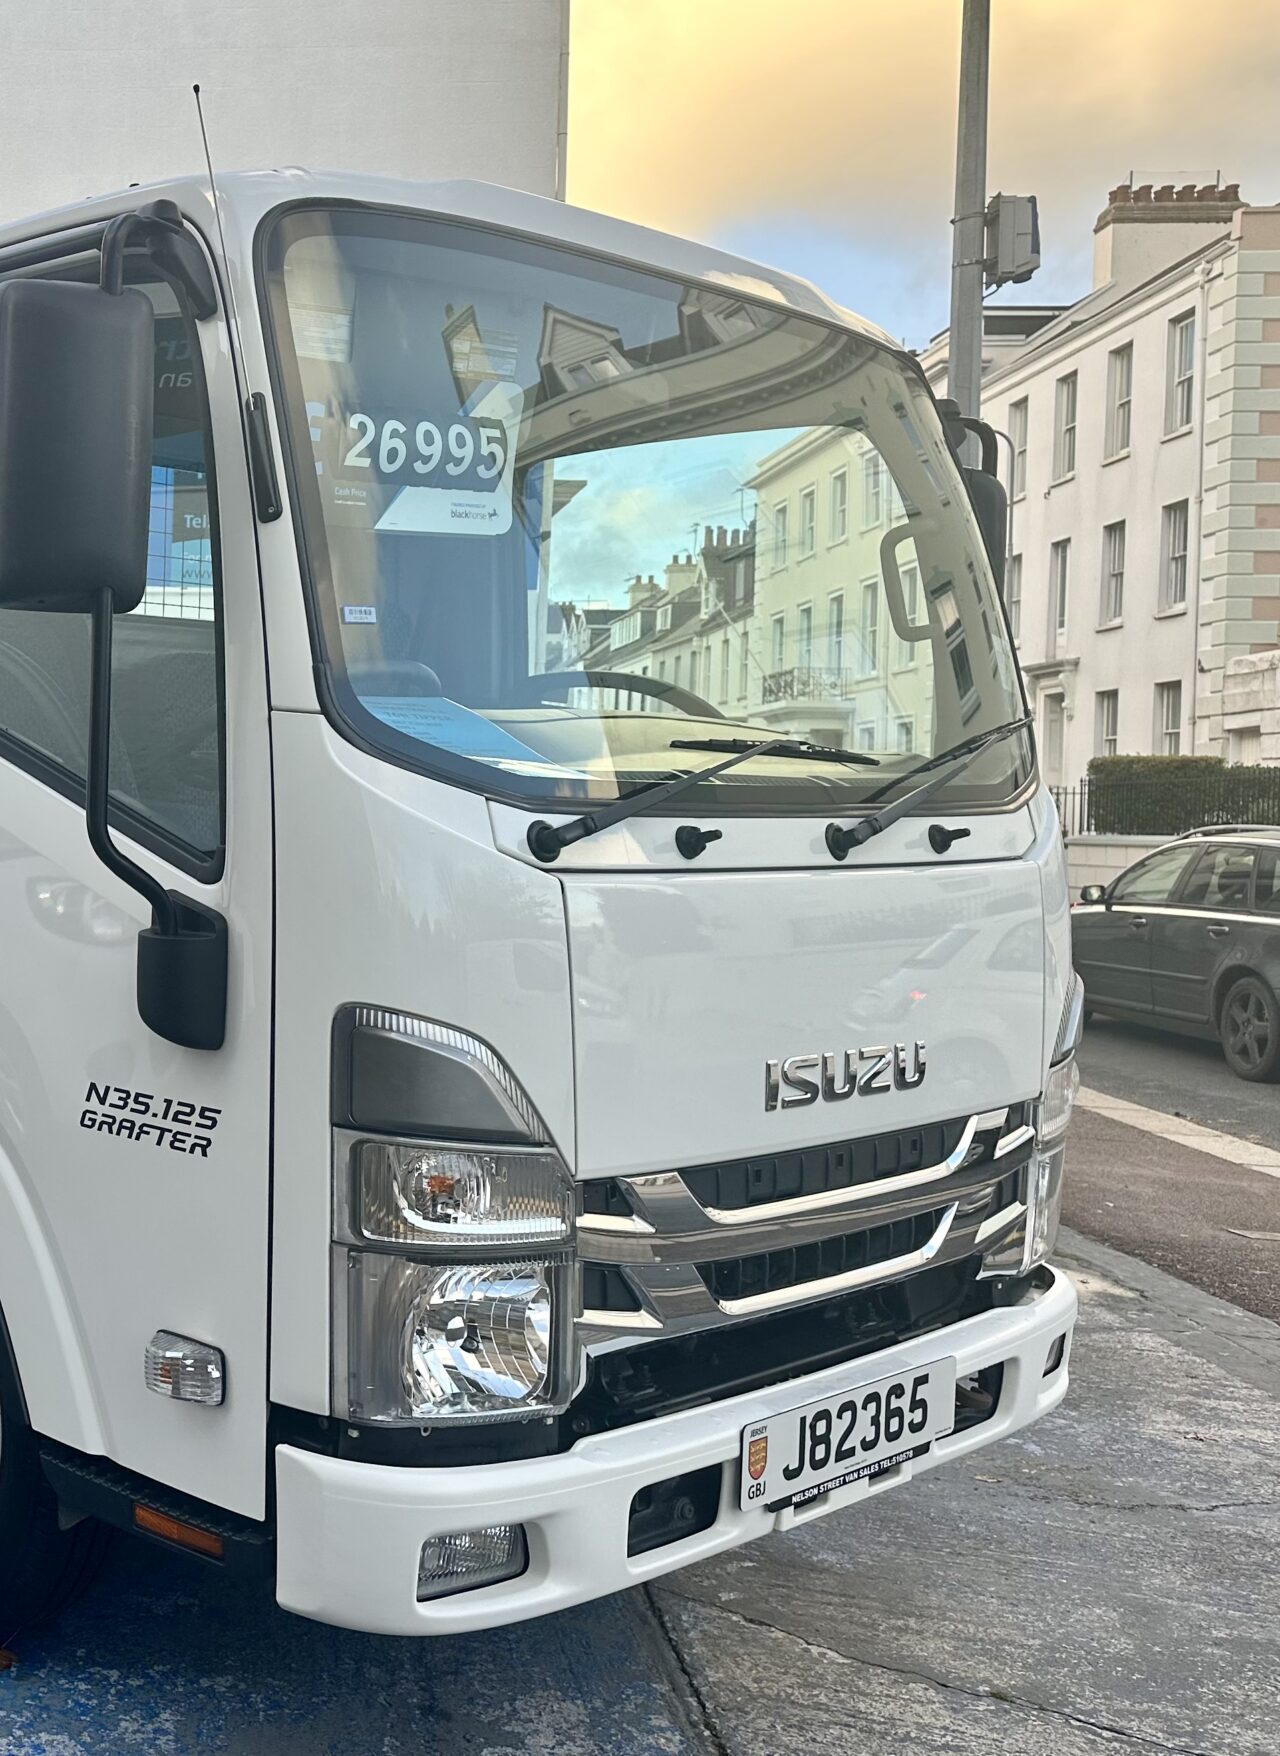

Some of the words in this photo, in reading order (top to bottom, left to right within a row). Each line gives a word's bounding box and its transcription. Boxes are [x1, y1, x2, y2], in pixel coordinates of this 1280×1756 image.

[343, 413, 505, 479] 26995
[334, 486, 350, 496] Cash
[351, 488, 367, 497] Price
[450, 508, 487, 520] blackhorse
[764, 1040, 926, 1112] ISUZU
[85, 1081, 222, 1131] N35.125
[79, 1109, 213, 1158] GRAFTER
[750, 1425, 768, 1438] JERSEY
[782, 1372, 930, 1482] J82365
[747, 1480, 766, 1500] GBJ
[791, 1485, 818, 1504] NELSON
[819, 1476, 845, 1494] STREET
[845, 1472, 858, 1484] VAN
[859, 1462, 879, 1477] SALES
